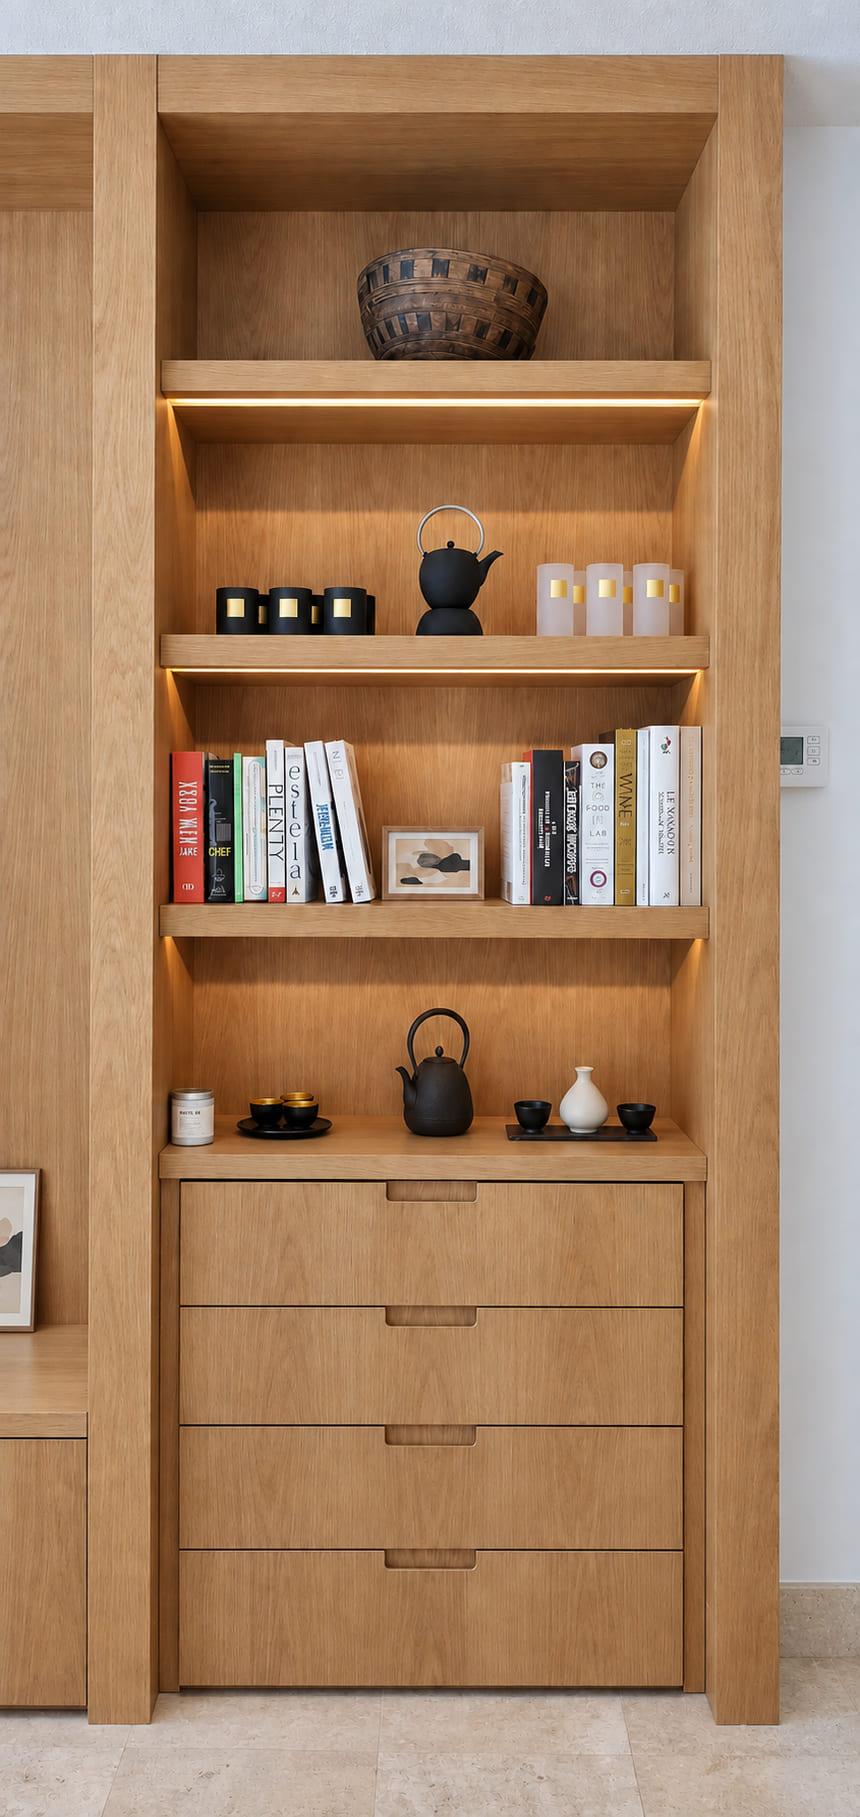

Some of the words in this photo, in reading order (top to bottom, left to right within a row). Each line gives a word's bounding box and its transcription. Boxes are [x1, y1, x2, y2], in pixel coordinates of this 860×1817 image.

[585, 804, 610, 812] FOOD
[618, 772, 633, 818] WINE
[268, 784, 285, 862] PLENTY
[288, 764, 302, 880] estela
[208, 846, 232, 858] CHEF
